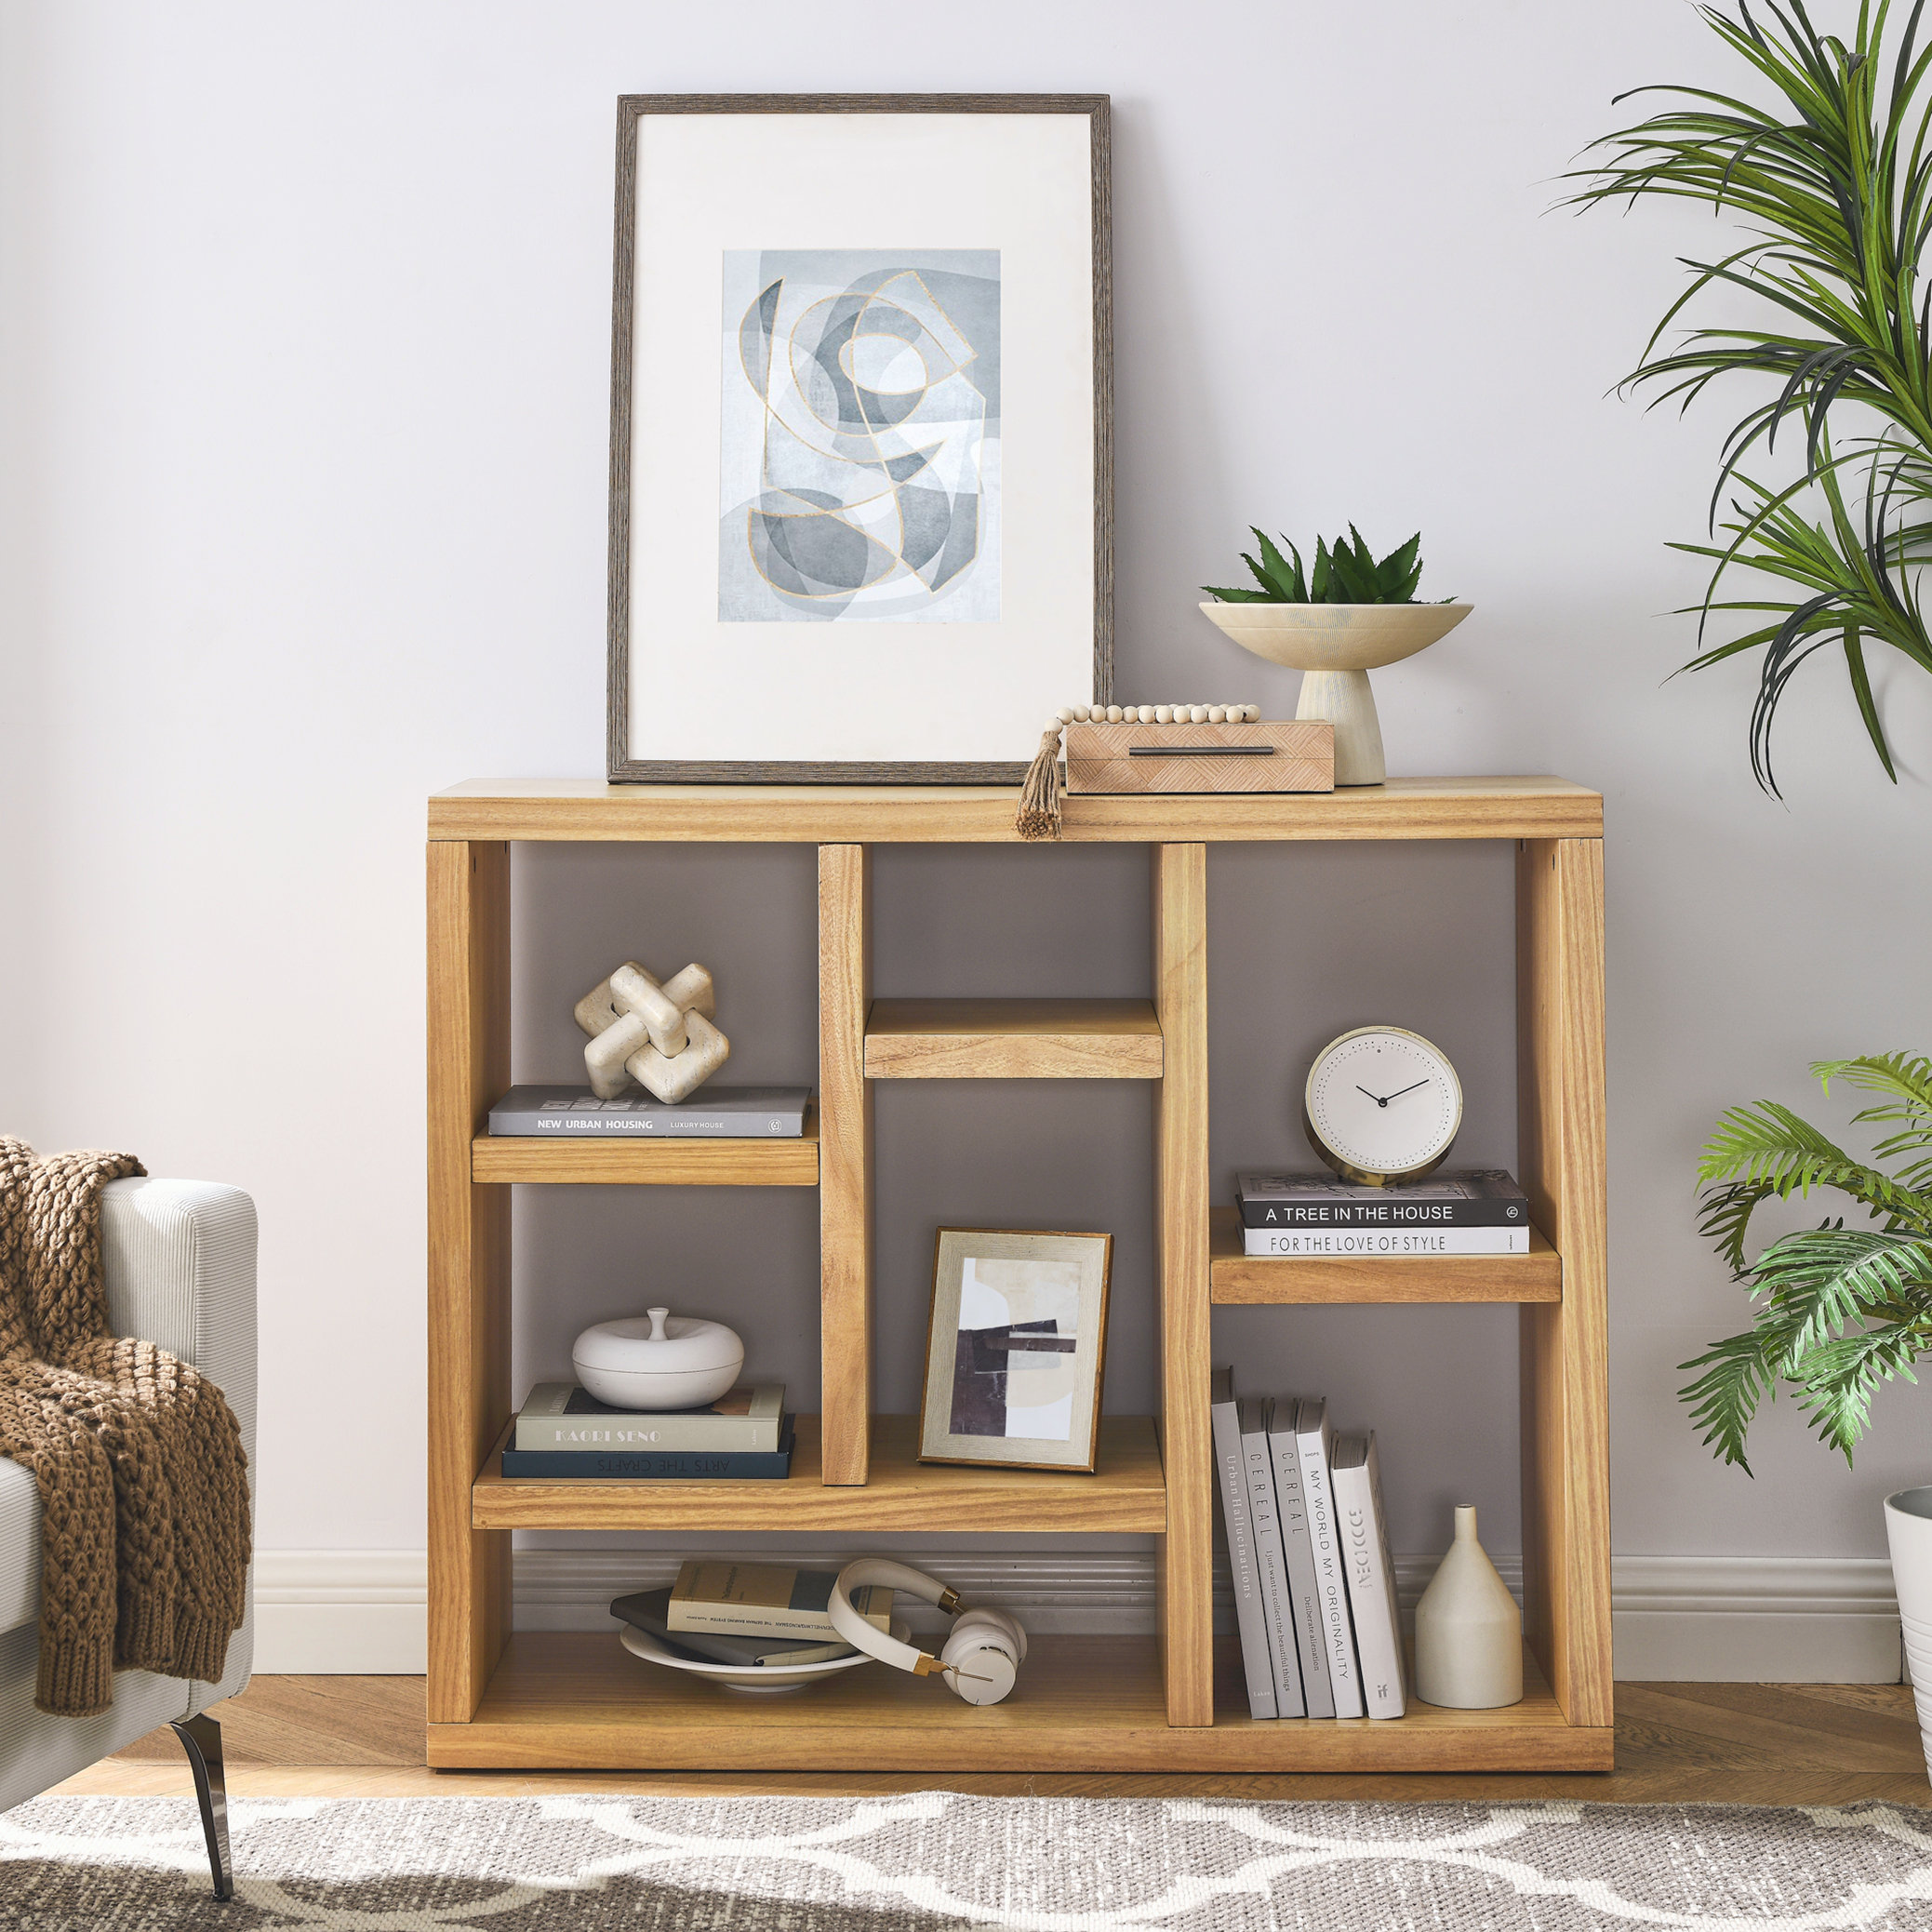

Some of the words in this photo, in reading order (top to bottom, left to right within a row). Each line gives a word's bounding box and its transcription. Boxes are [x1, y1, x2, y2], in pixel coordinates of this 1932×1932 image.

[537, 1119, 562, 1129] NEW
[566, 1120, 602, 1129] URBAN
[606, 1120, 653, 1129] HOUSING
[1265, 1208, 1278, 1221] A
[1284, 1207, 1329, 1221] TREE
[1334, 1207, 1351, 1220] IN
[1352, 1207, 1388, 1220] THE
[1393, 1206, 1453, 1220] HOUSE
[1271, 1237, 1300, 1251] FOR
[1304, 1237, 1331, 1251] THE
[1336, 1236, 1373, 1251] LOVE
[1379, 1236, 1399, 1251] OF
[1403, 1235, 1446, 1251] STYLE
[555, 1430, 610, 1443] KAORI
[617, 1430, 661, 1443] SENO
[597, 1459, 651, 1472] CRAFTS
[659, 1459, 687, 1472] THE
[694, 1459, 730, 1472] ARTS
[1310, 1470, 1322, 1490] MY
[1250, 1453, 1272, 1536] CEREAL
[1282, 1452, 1304, 1535] CEREAL
[1226, 1455, 1238, 1495] Urban
[1232, 1499, 1252, 1599] Hallucinations
[1314, 1497, 1330, 1551] WORLD
[1265, 1553, 1274, 1568] just
[1323, 1557, 1334, 1578] MY
[1272, 1597, 1281, 1621] collect
[1275, 1621, 1284, 1634] the
[1304, 1596, 1314, 1633] Deliberate
[1310, 1634, 1320, 1672] alienation
[1326, 1585, 1349, 1679] ORIGINALITY
[1277, 1635, 1289, 1669] beautiful
[1282, 1669, 1290, 1692] things
